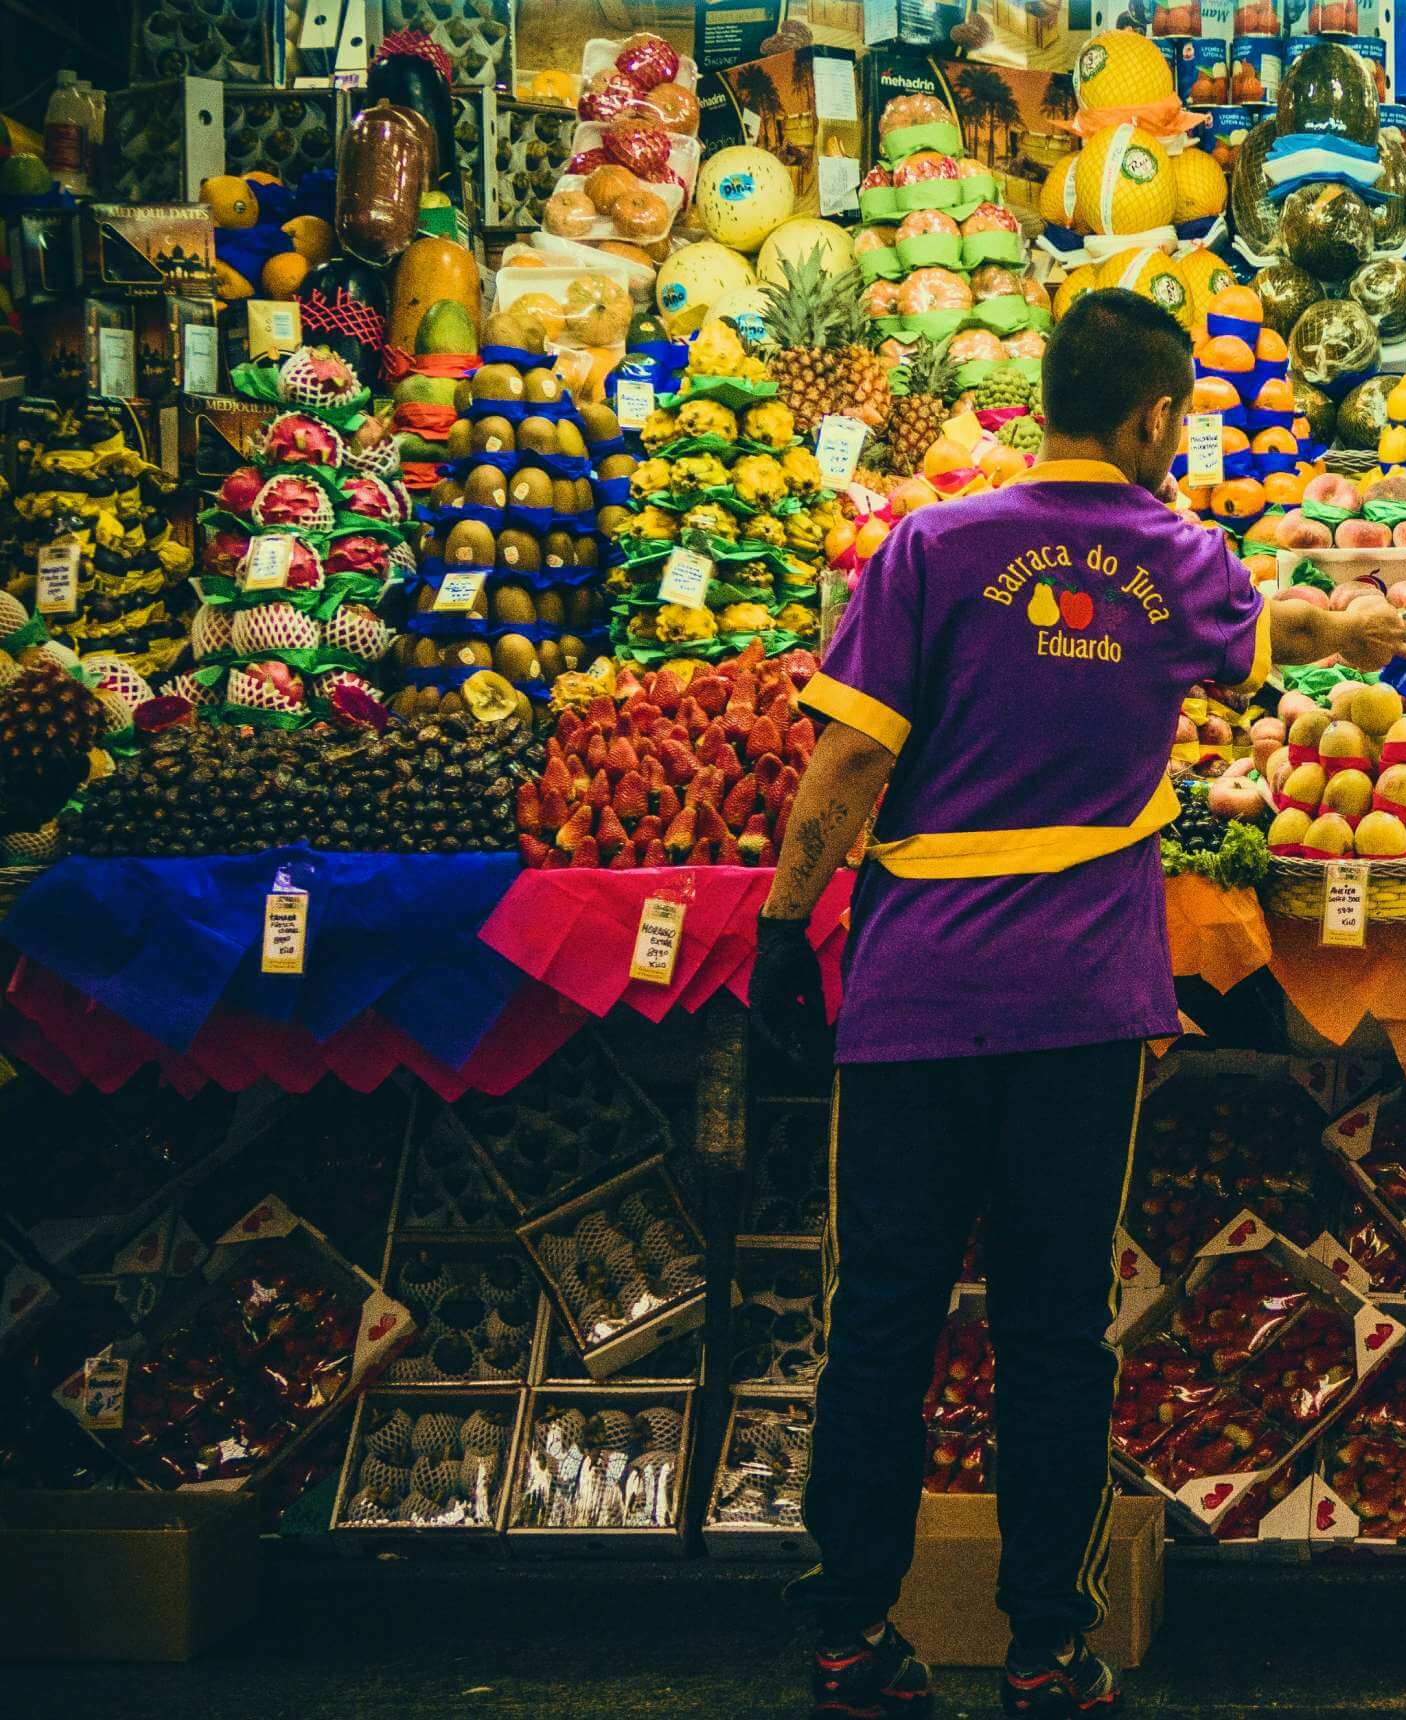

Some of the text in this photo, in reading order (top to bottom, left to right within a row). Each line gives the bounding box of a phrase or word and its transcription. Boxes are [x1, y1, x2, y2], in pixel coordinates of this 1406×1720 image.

[881, 75, 935, 91] mehadrin
[983, 544, 1170, 625] Barraca do Juca
[1037, 629, 1122, 663] Eduardo
